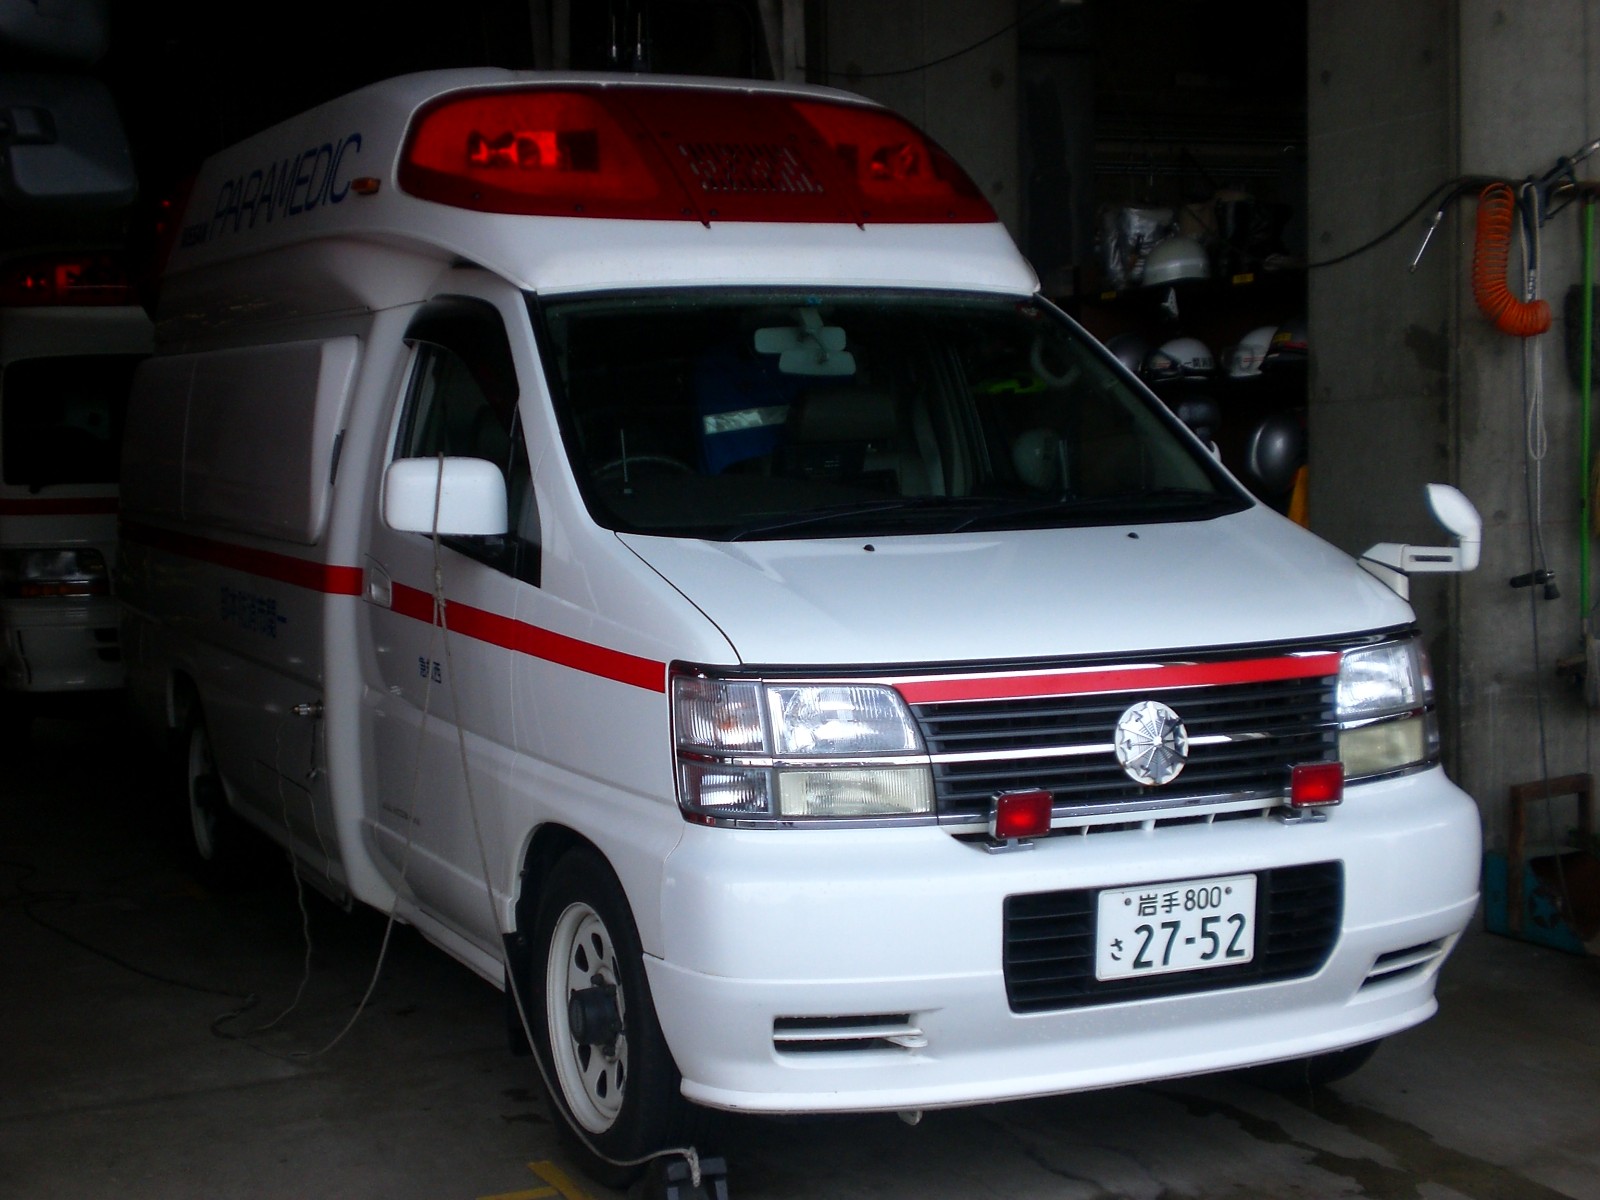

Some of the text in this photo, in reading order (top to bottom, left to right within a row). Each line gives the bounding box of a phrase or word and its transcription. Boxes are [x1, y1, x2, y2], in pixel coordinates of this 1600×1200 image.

[208, 132, 363, 241] PARAMEDIC
[1110, 912, 1247, 970] さ 27-52
